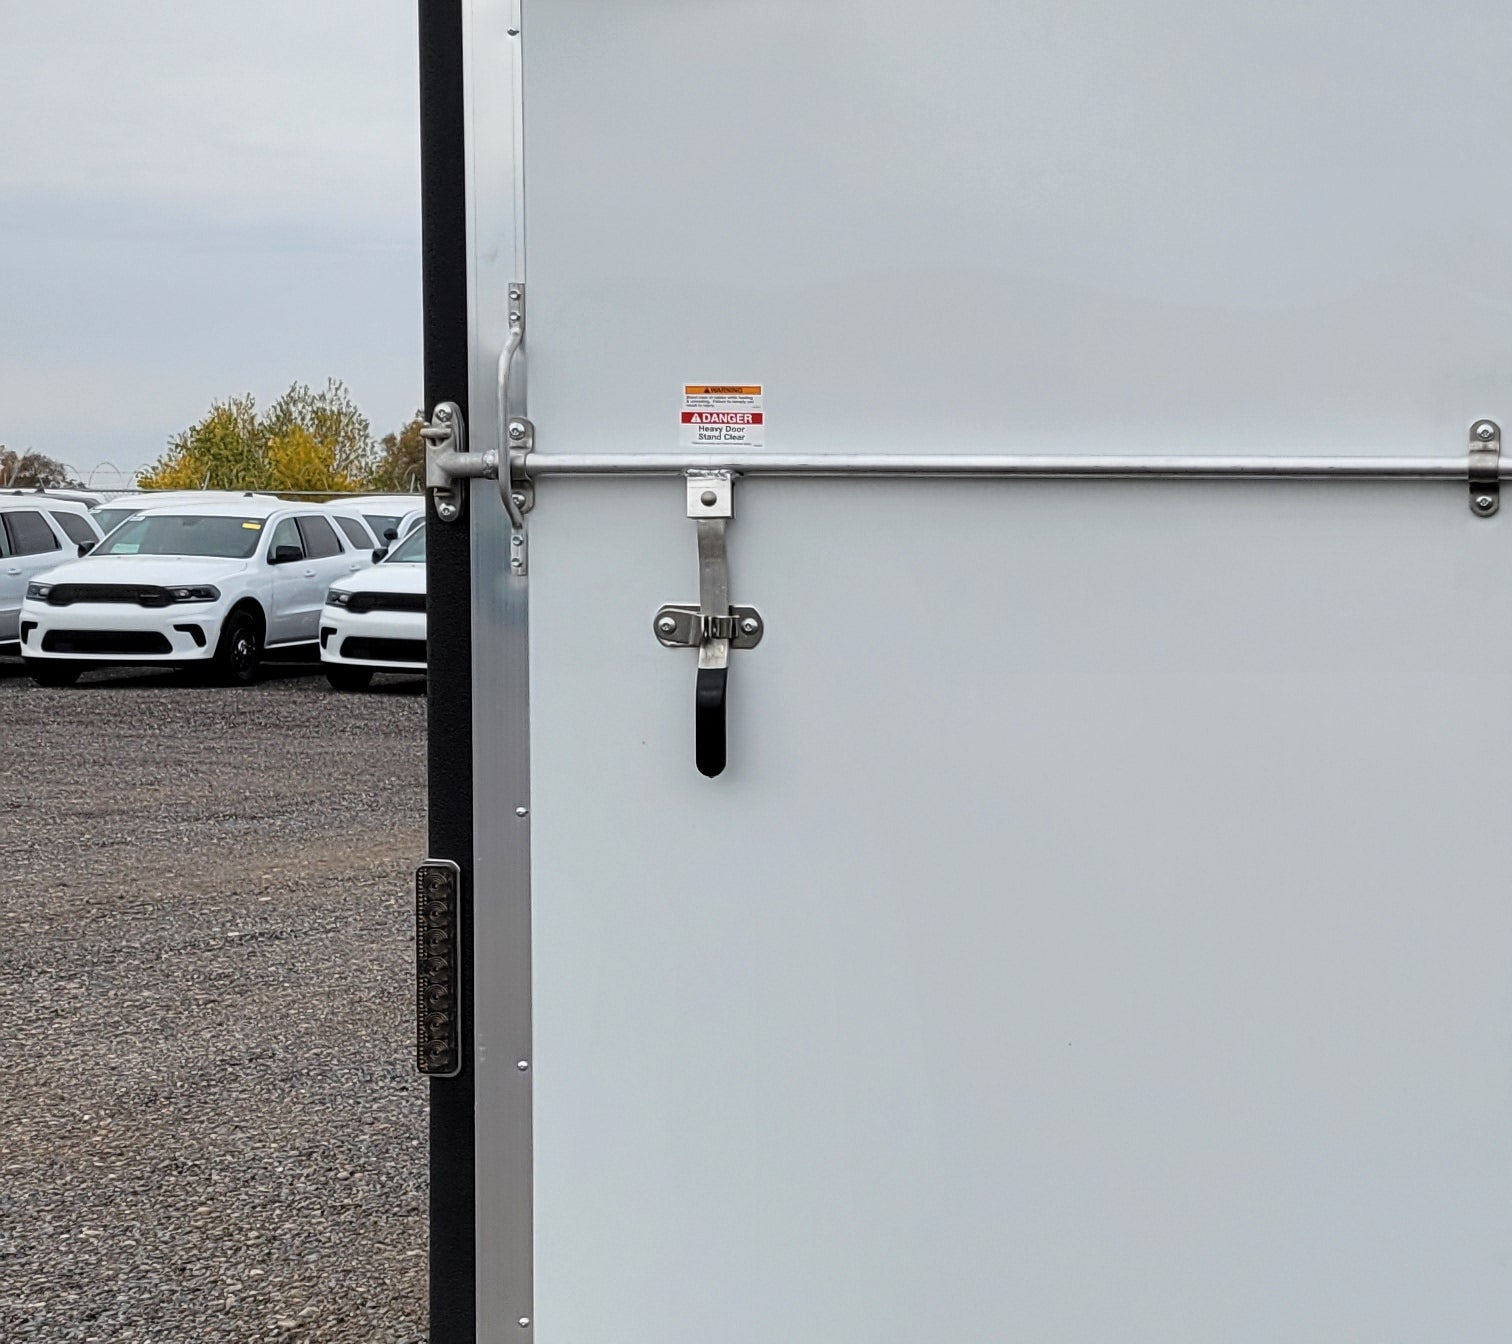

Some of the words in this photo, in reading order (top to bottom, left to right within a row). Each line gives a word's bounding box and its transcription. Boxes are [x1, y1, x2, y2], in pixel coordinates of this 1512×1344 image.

[710, 386, 744, 394] WARNING
[702, 413, 753, 424] DANGER
[698, 425, 723, 435] Heavy
[725, 425, 746, 433] Door
[698, 433, 722, 441] Stand
[723, 433, 746, 441] Clear
